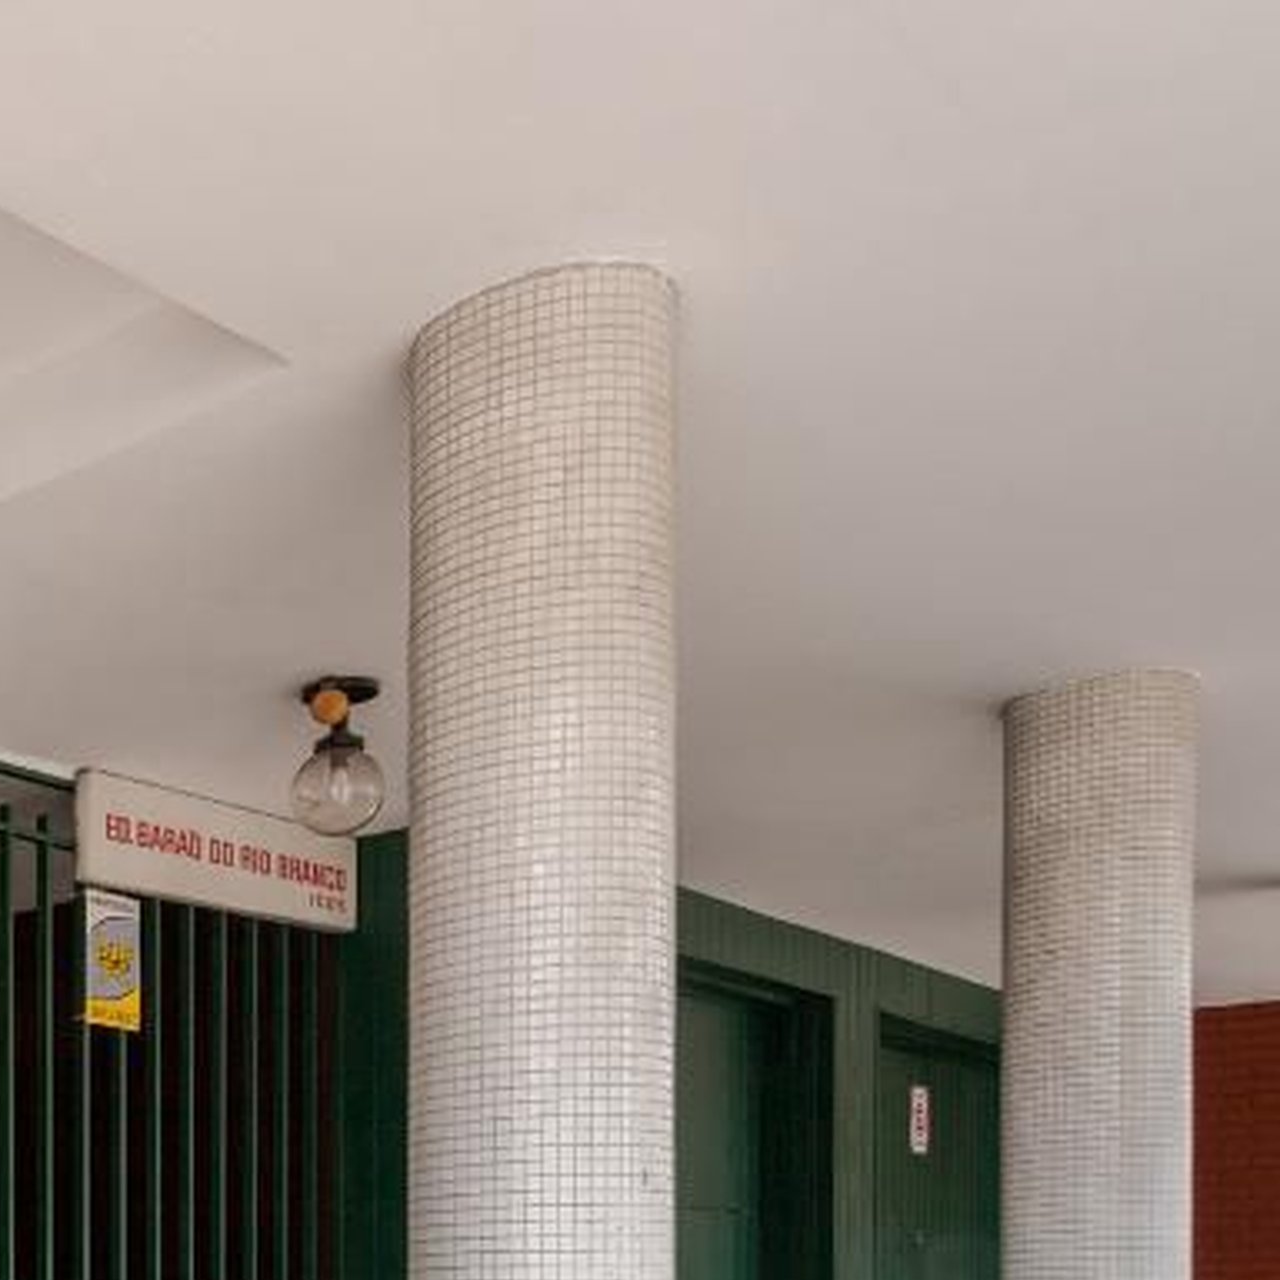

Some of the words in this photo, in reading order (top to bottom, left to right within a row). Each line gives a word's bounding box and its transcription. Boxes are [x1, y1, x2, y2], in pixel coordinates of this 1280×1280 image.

[209, 838, 234, 867] DO
[241, 844, 271, 874] RIO
[278, 854, 347, 892] BRANCO
